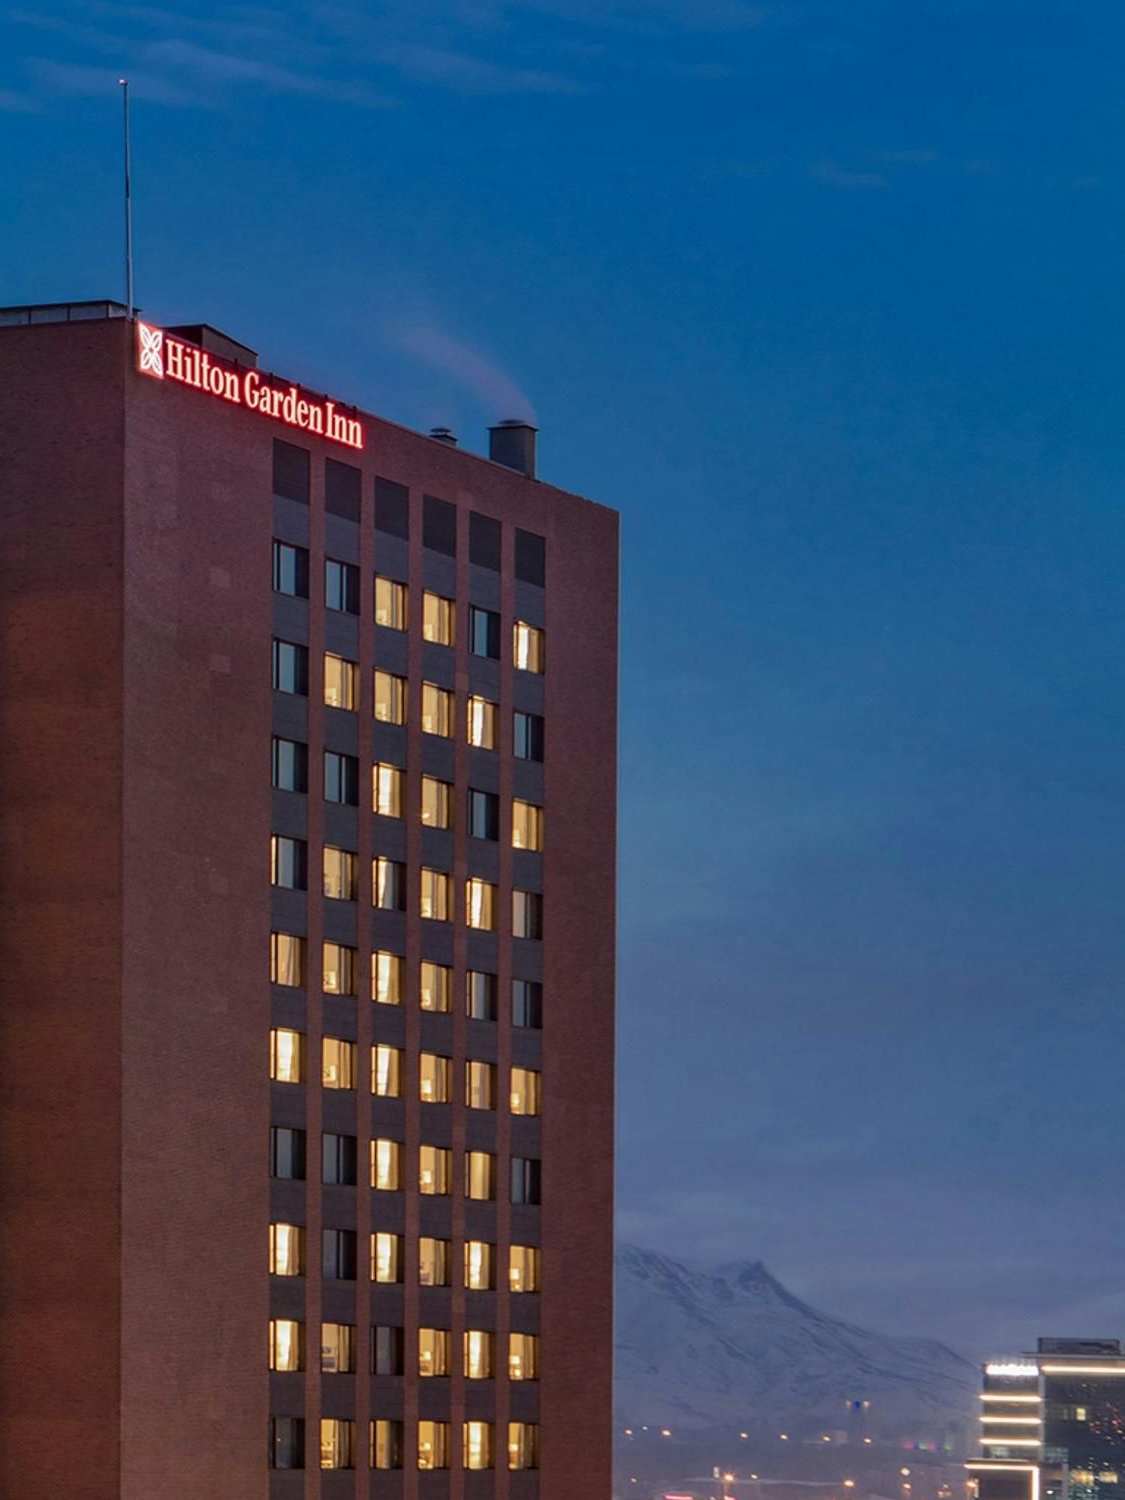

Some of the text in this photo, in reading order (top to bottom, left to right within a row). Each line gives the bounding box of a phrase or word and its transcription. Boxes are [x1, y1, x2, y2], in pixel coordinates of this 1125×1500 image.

[165, 339, 364, 449] Hilton Garden Inn
